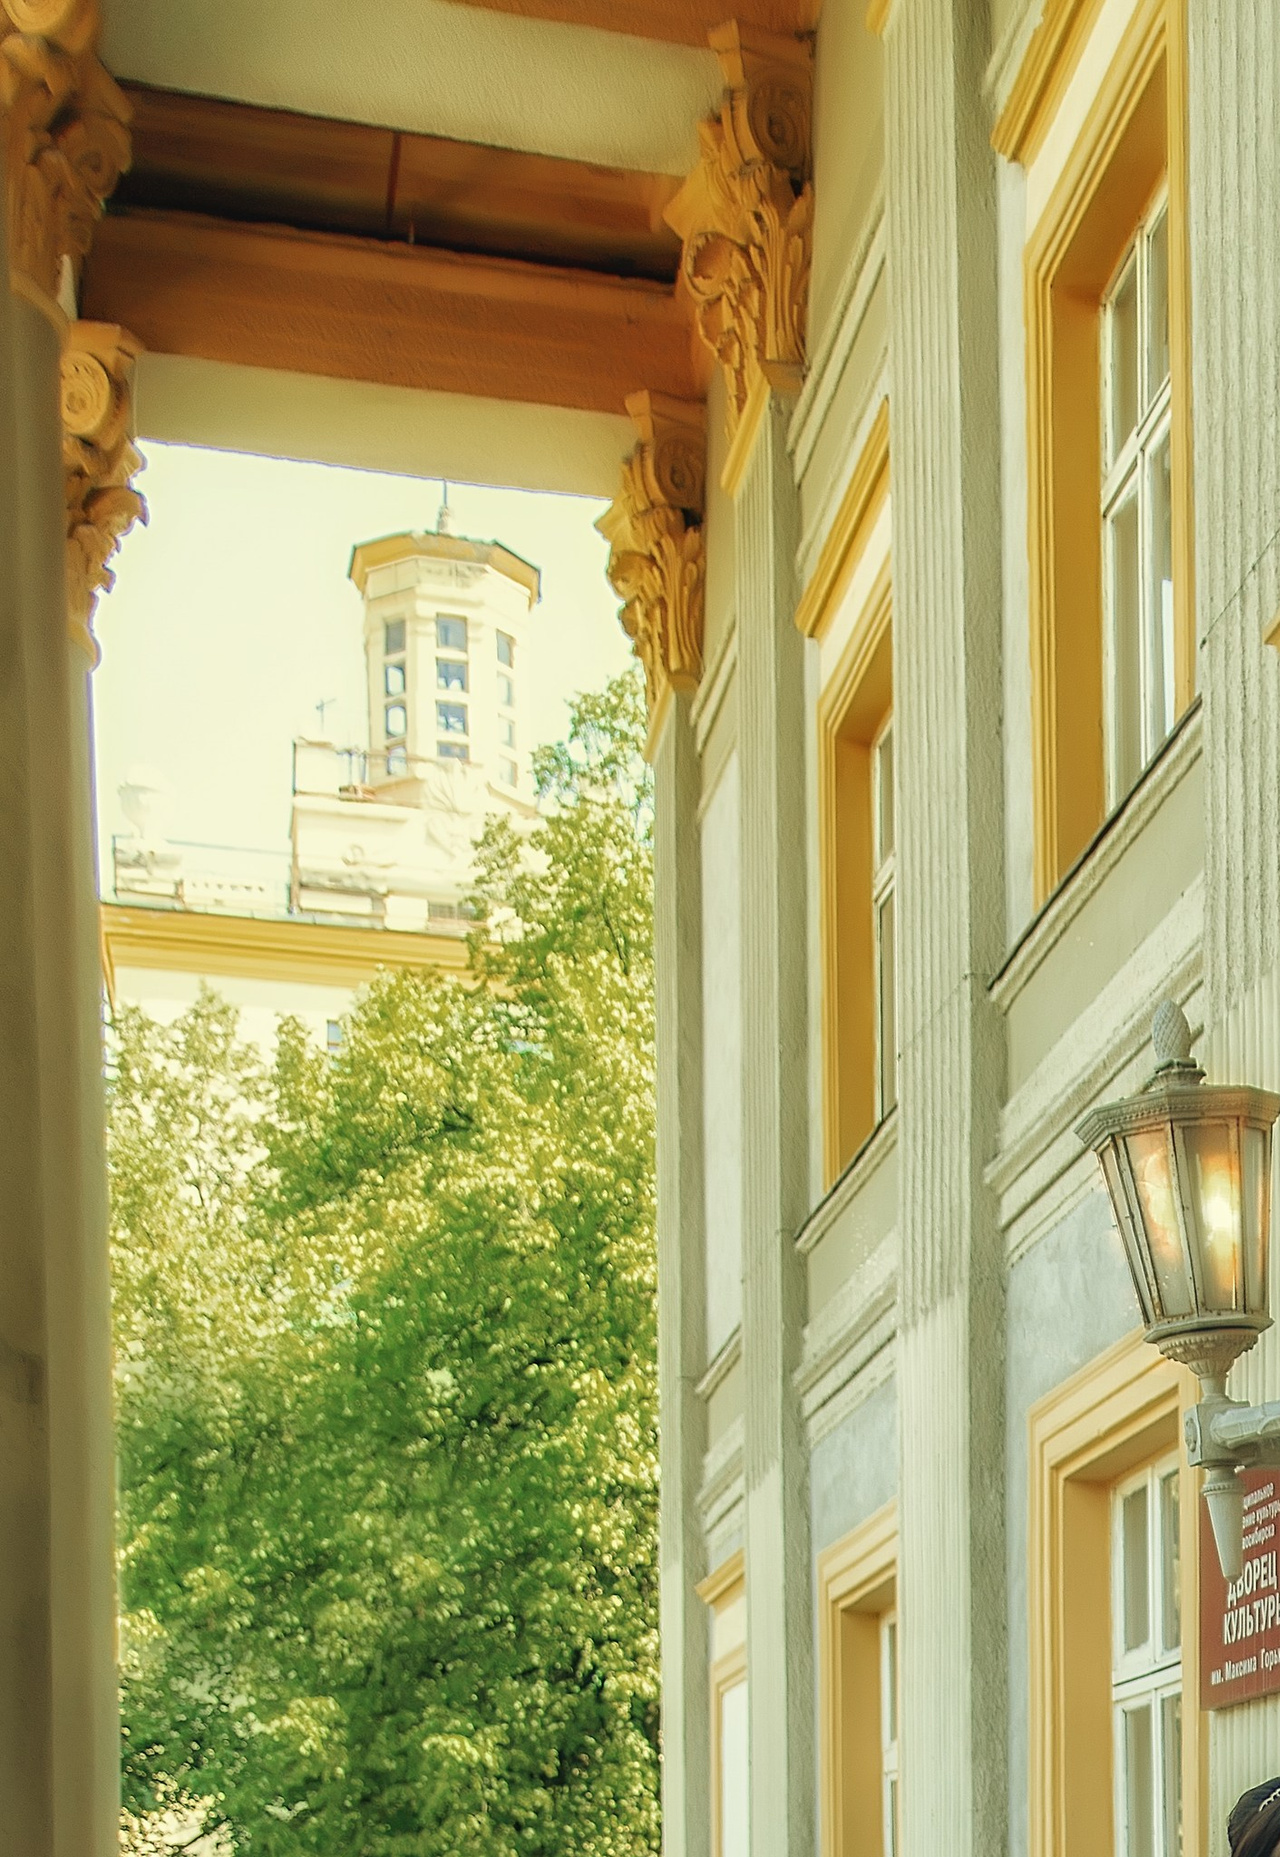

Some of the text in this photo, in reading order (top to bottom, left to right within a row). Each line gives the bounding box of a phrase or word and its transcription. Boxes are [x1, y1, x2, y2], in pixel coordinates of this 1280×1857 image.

[1243, 1482, 1274, 1510] ципальное
[1211, 1669, 1224, 1685] им.
[1225, 1660, 1257, 1681] Максима
